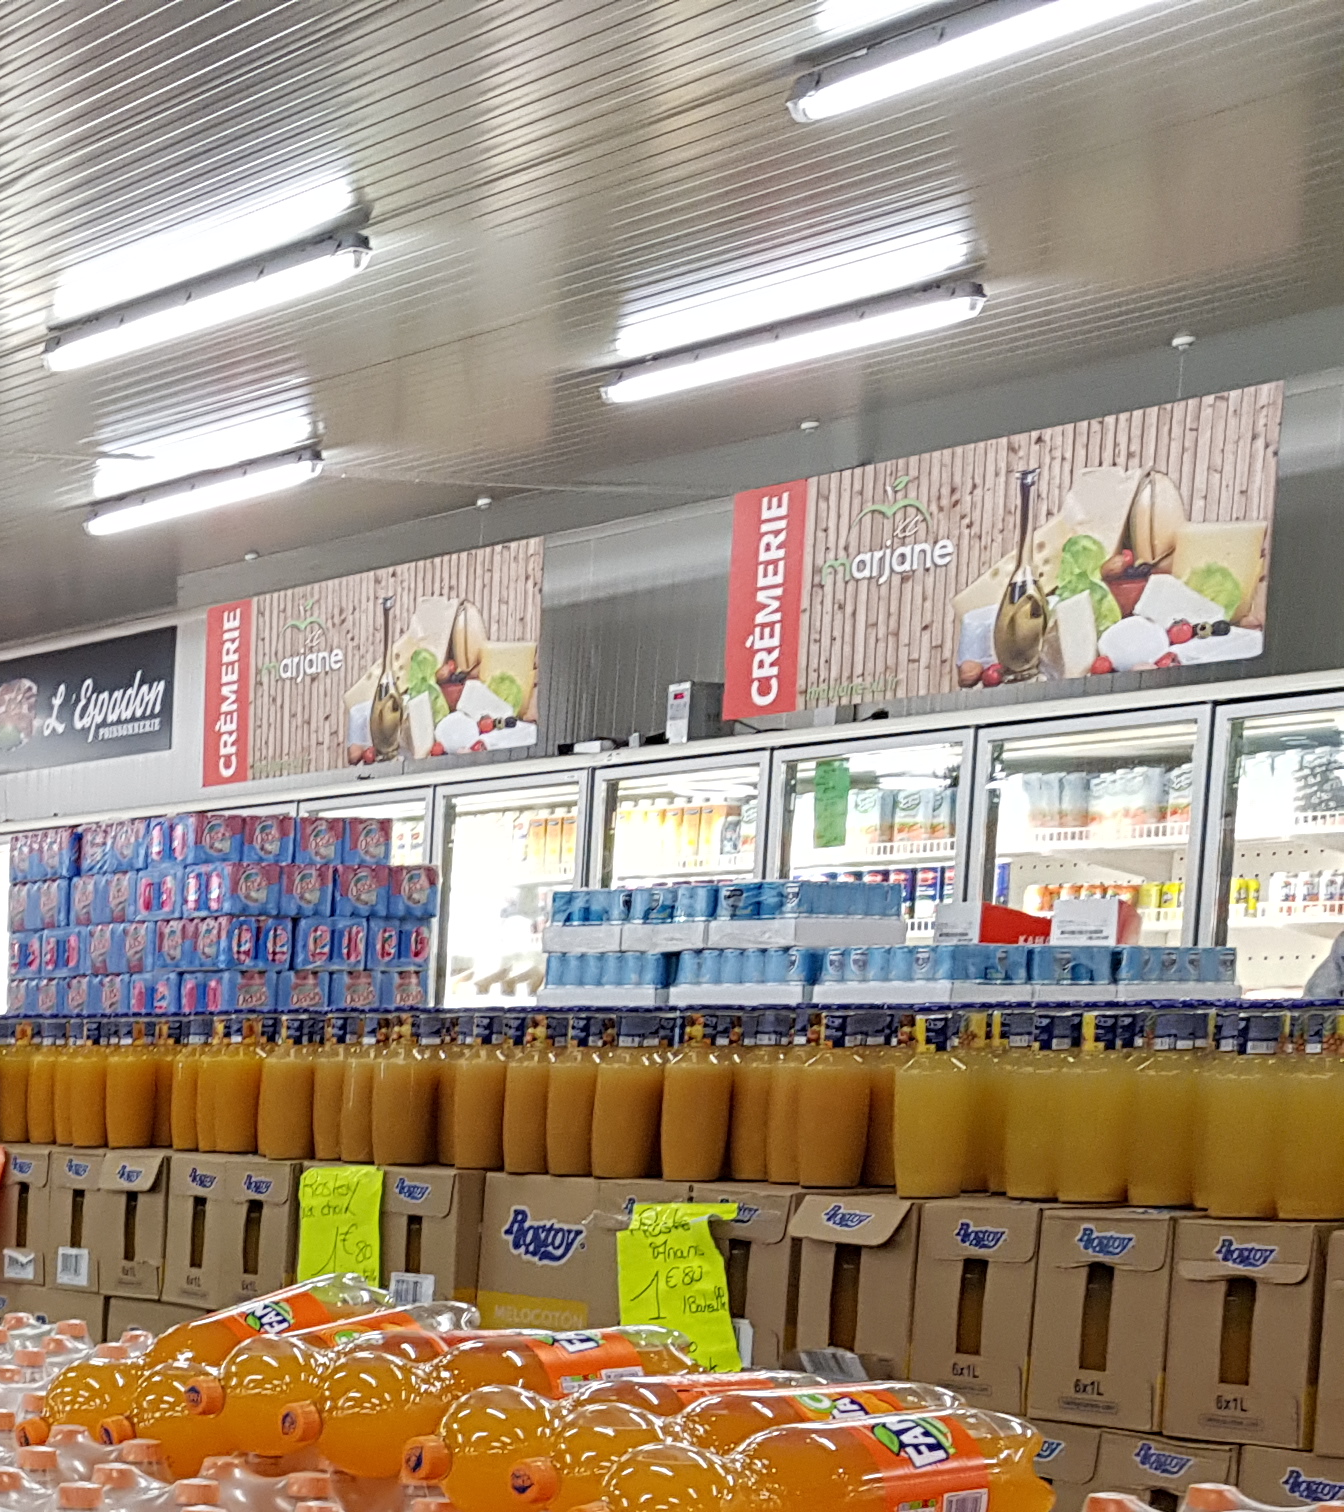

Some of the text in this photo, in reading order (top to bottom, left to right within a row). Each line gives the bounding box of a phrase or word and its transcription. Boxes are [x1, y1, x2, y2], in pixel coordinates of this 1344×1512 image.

[821, 538, 955, 586] marjane
[745, 491, 790, 707] CRÈMERIE
[262, 648, 344, 683] marjane
[215, 608, 241, 778] CRÈMERIE
[504, 1209, 584, 1263] Rostoy
[956, 1221, 1006, 1250] Rostoy
[1077, 1227, 1134, 1257] Rostoy
[1216, 1239, 1278, 1268] Rostoy
[952, 1362, 980, 1379] 6x1L
[1074, 1379, 1104, 1397] 6x1L
[1216, 1395, 1248, 1413] 6x1L
[1134, 1443, 1193, 1476] Rostoy
